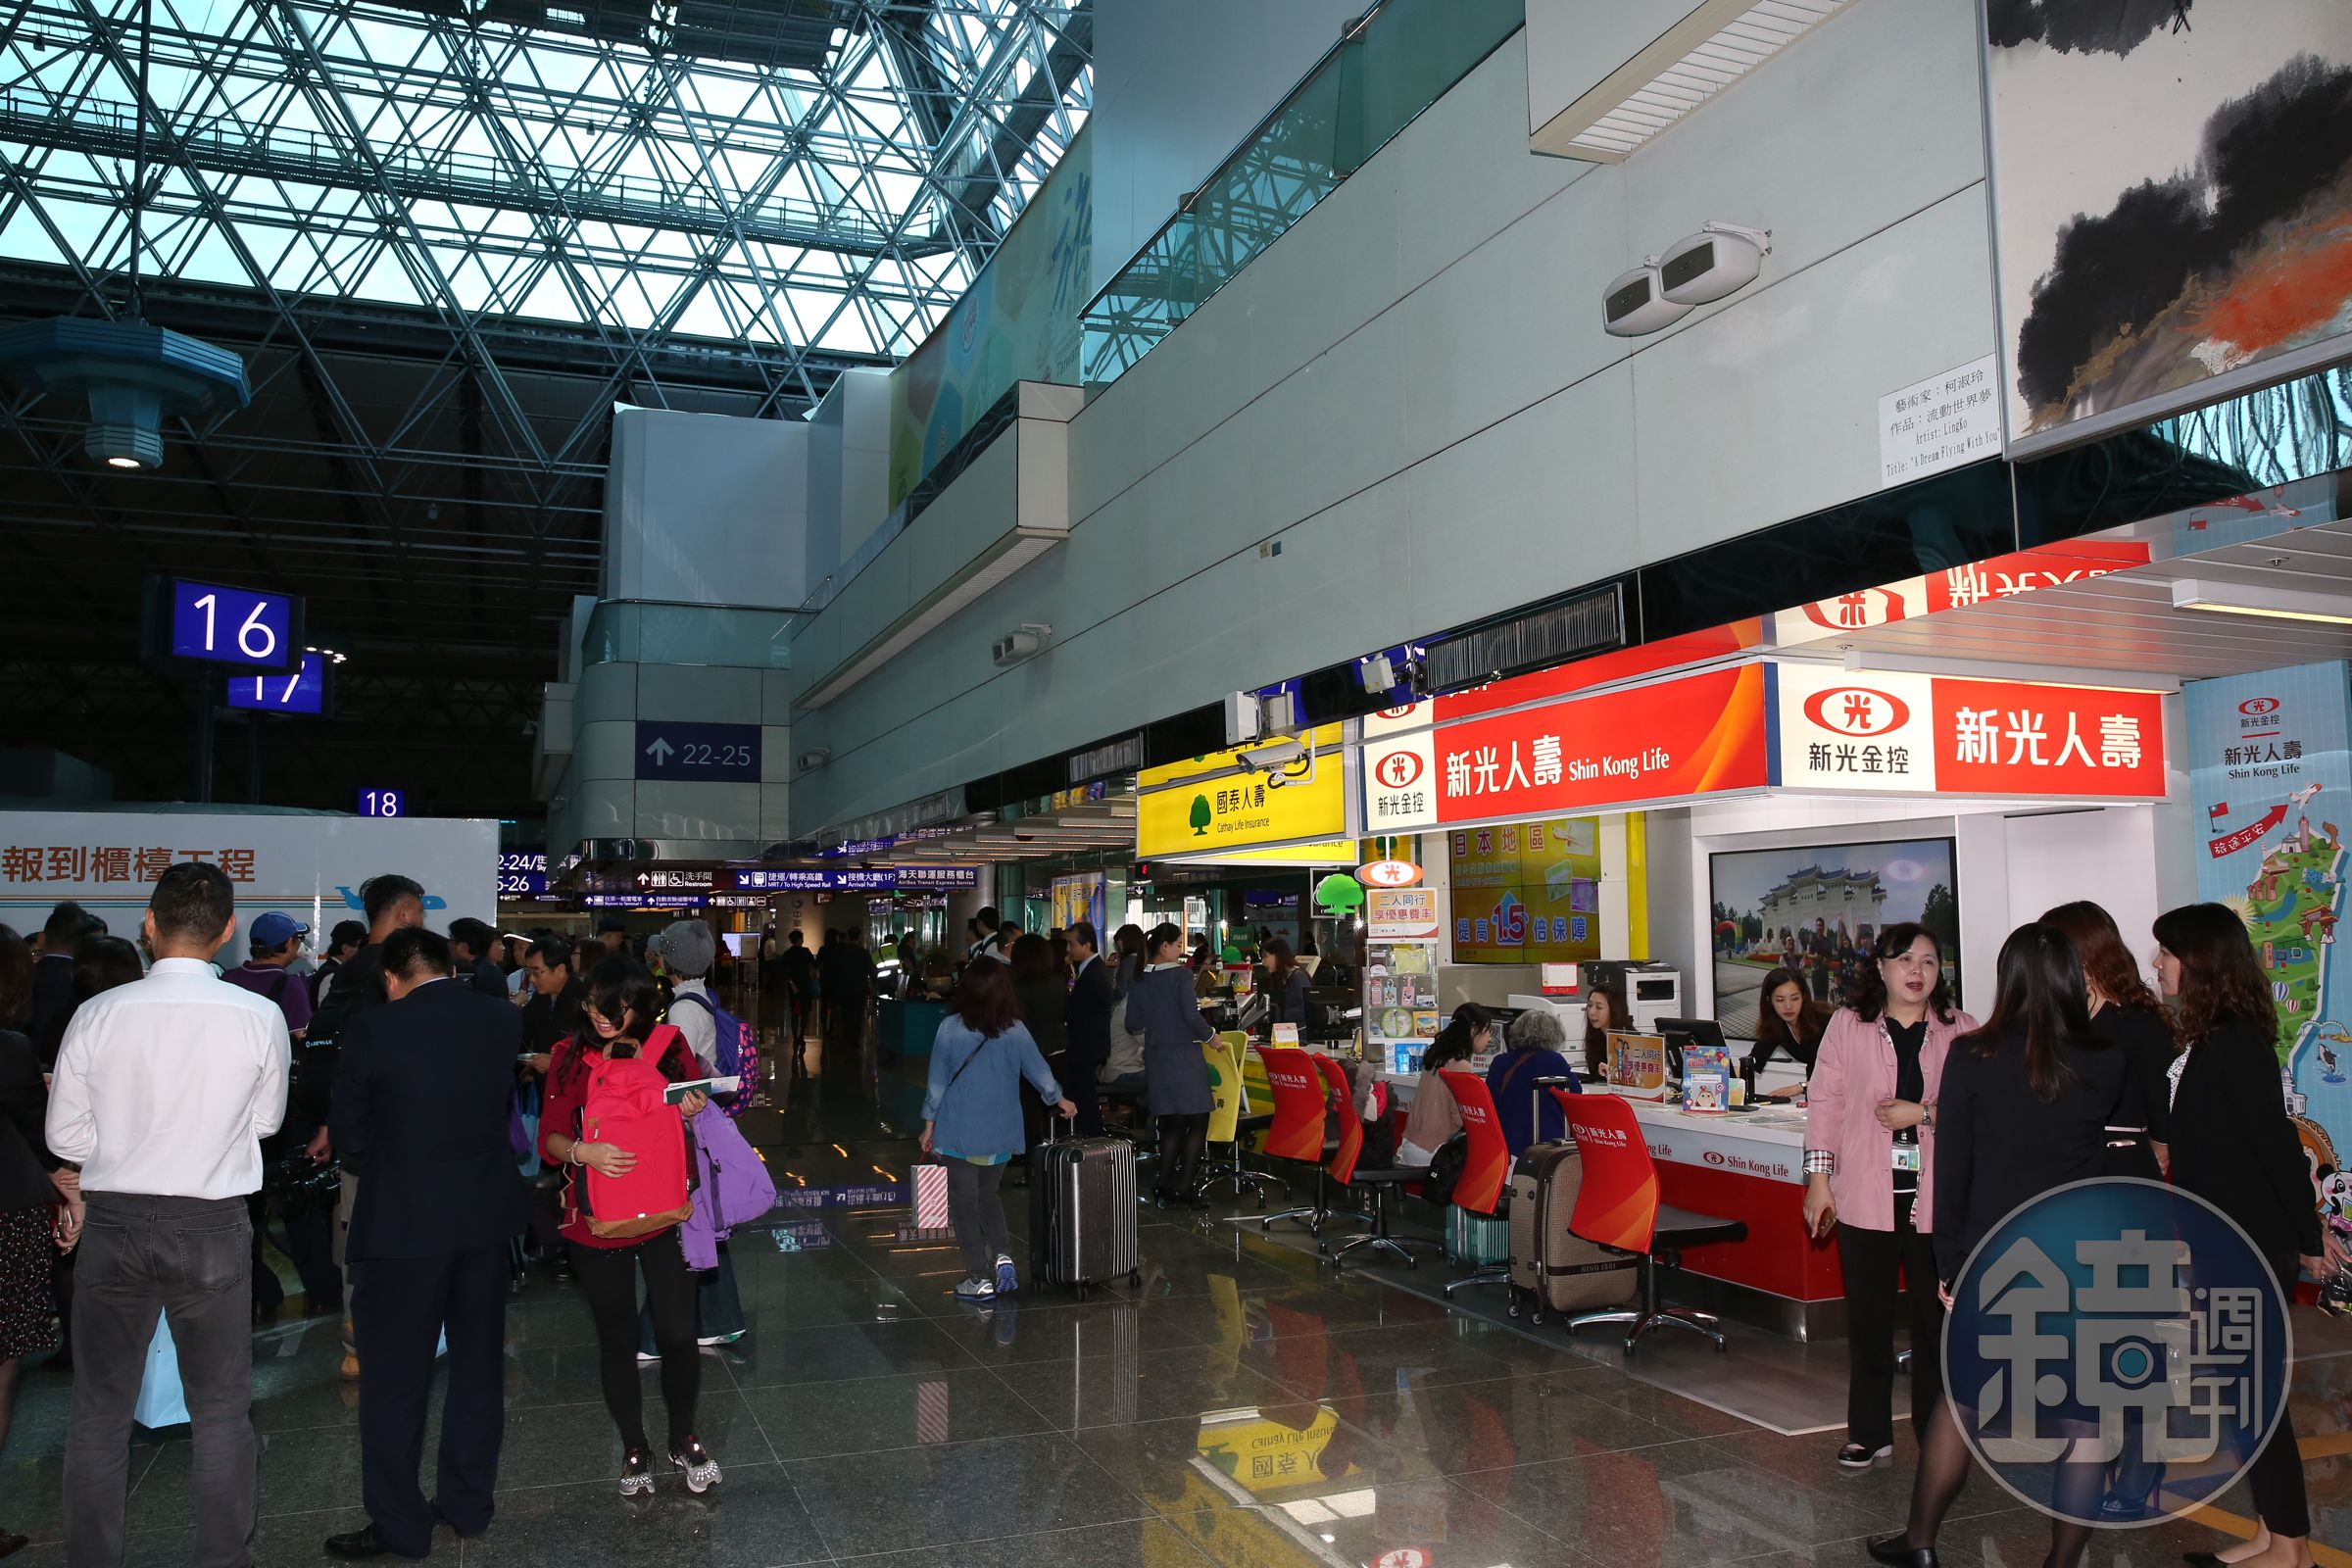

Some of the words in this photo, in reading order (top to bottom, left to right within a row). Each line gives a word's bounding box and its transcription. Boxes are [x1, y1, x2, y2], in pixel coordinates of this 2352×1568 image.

[1916, 428, 1941, 446] Artist:
[1943, 418, 1968, 436] LingKo
[1886, 461, 1908, 477] Title:
[1920, 451, 1939, 466] Dream
[1941, 442, 1965, 459] Flying
[1967, 436, 1984, 450] With
[194, 594, 275, 659] 16
[1843, 693, 1872, 729] 光
[2253, 700, 2265, 712] 光
[2240, 714, 2280, 728] 新光金控
[1955, 707, 2141, 769] 新光人壽
[682, 744, 751, 766] 22-25
[1569, 759, 1599, 781] Shin
[1603, 755, 1640, 780] Kong
[1642, 747, 1670, 771] Life
[1808, 742, 1910, 775] 新光金控
[2224, 740, 2303, 766] 新光人壽
[1392, 758, 1406, 783] 光
[1446, 734, 1563, 799] 新光人壽
[2228, 768, 2250, 780] Shin
[2253, 765, 2278, 778] Kong
[2281, 763, 2300, 775] Life
[366, 791, 397, 816] 18
[1216, 784, 1265, 814] 國泰人壽
[1378, 791, 1424, 816] 新光金控
[1216, 821, 1234, 834] Cathay
[1234, 819, 1245, 831] Life
[1245, 817, 1270, 829] Insurance
[1455, 823, 1544, 858] 日本地區
[685, 871, 712, 881] 洗手間
[1385, 864, 1400, 882] 光
[1380, 894, 1425, 906] 二人同行
[1374, 908, 1432, 920] 享優惠費率
[1589, 1127, 1627, 1141] 新光人壽
[1658, 1144, 1672, 1156] Life
[1728, 1155, 1746, 1169] Shin
[1748, 1159, 1771, 1177] Kong
[1773, 1163, 1788, 1177] Life
